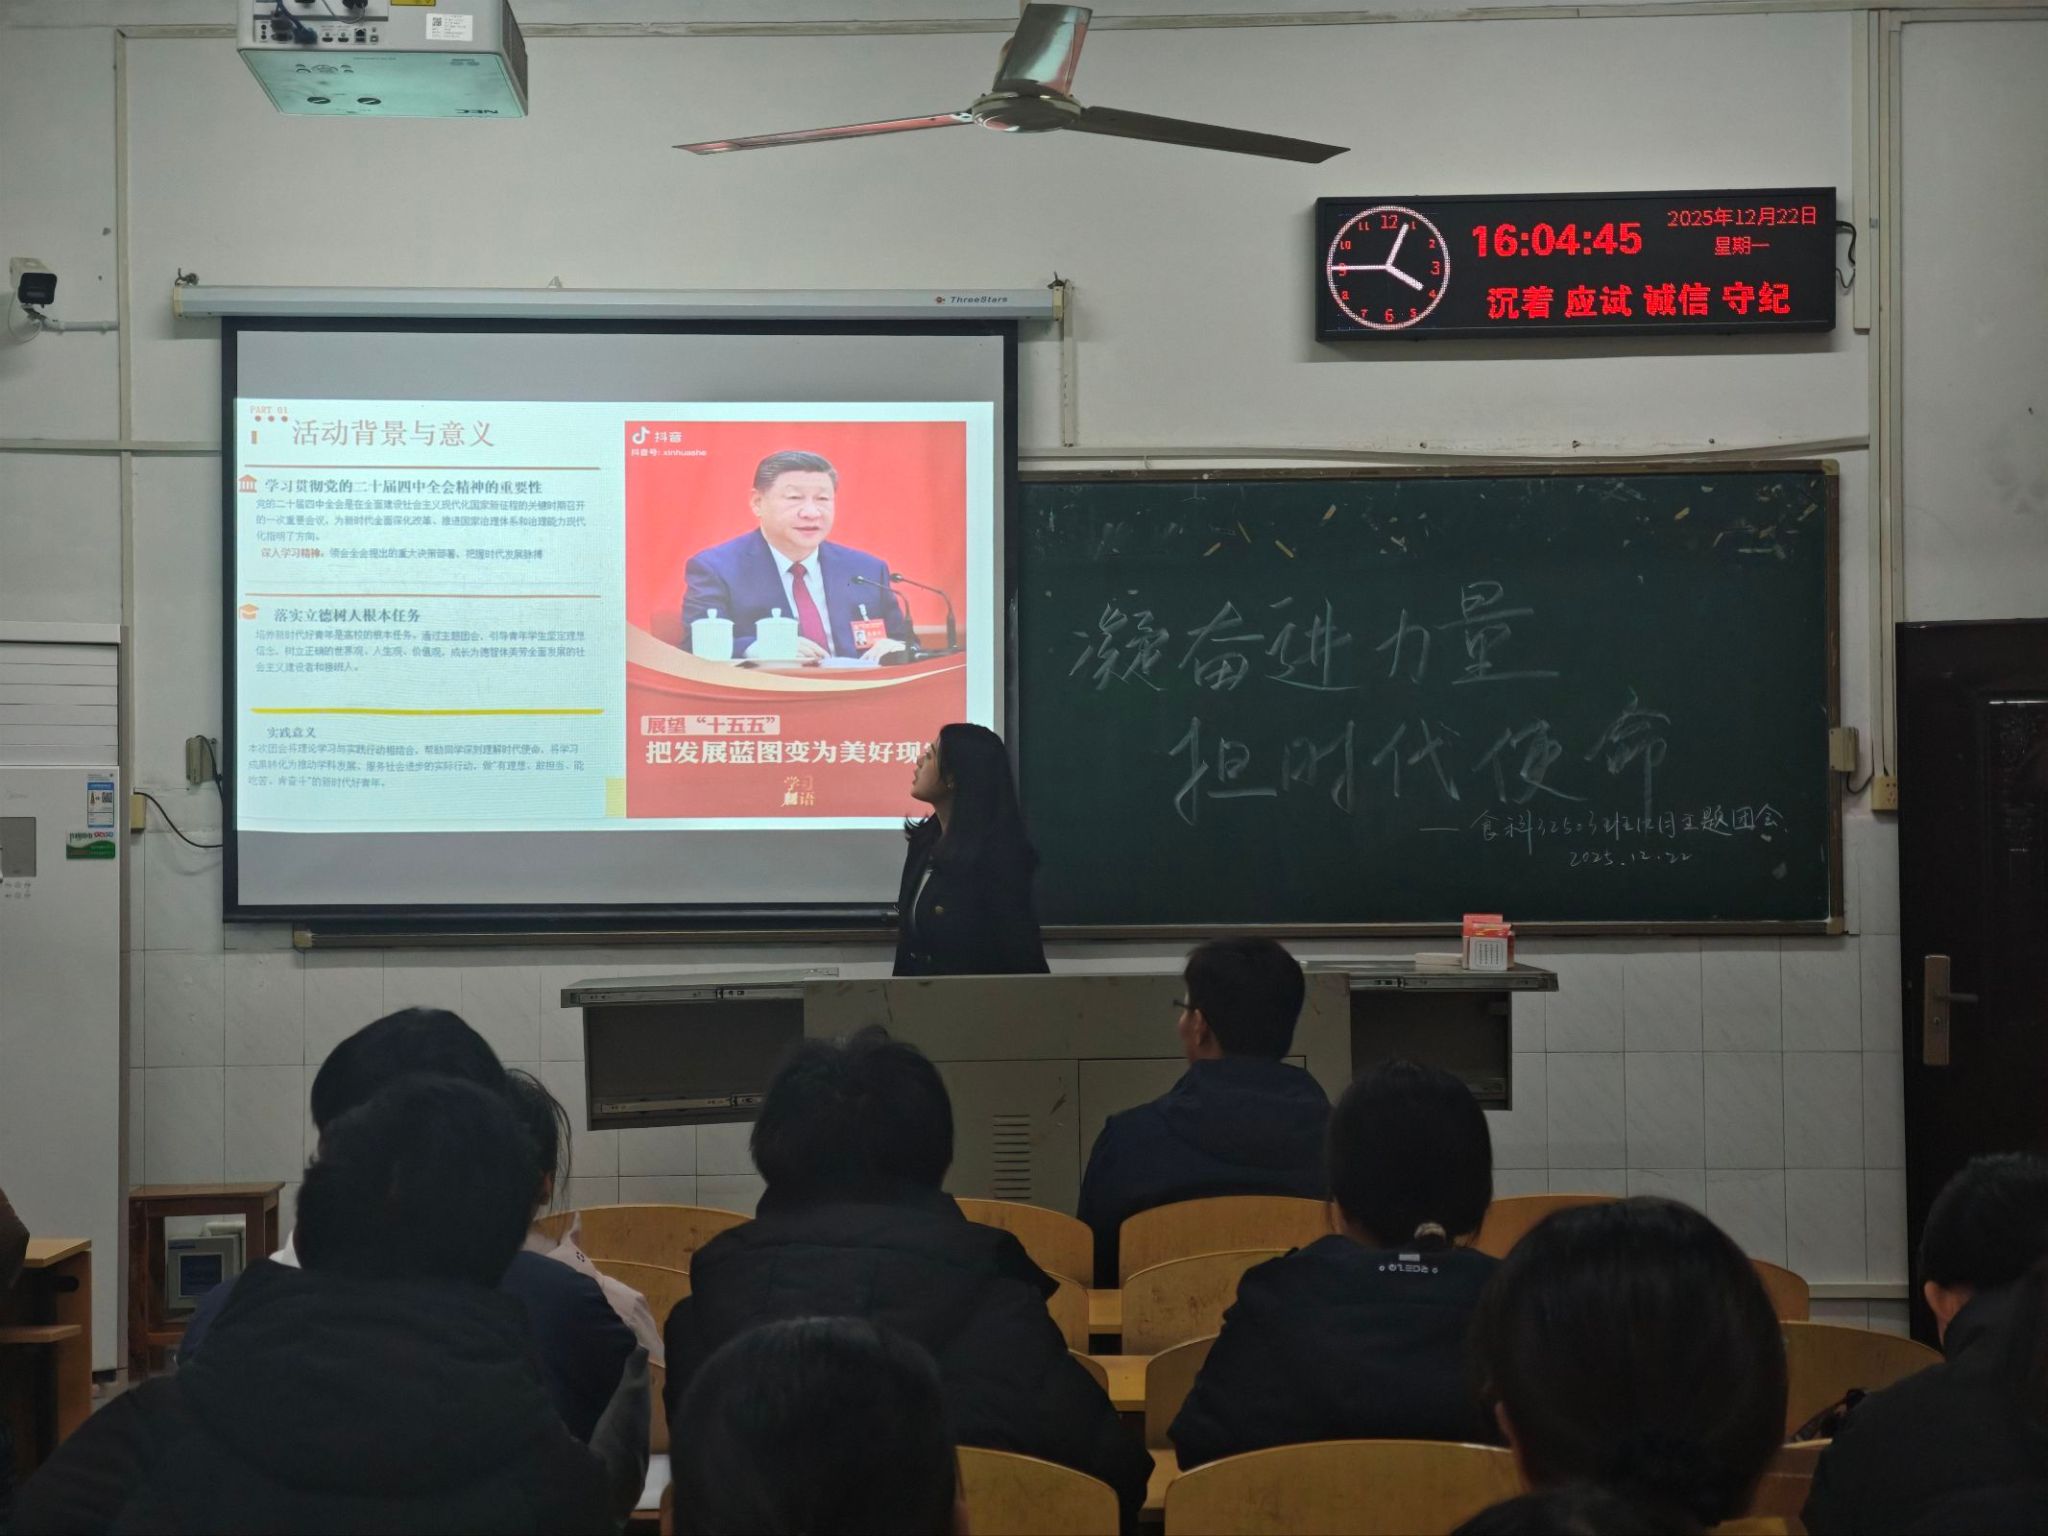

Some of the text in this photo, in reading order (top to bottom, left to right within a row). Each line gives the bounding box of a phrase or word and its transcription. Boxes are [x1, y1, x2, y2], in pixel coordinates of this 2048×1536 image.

[1381, 215, 1398, 229] 12
[1667, 206, 1817, 227] 2025年12月22日
[1359, 222, 1370, 231] 11
[1340, 240, 1351, 250] 10
[1429, 239, 1436, 249] 2
[1473, 222, 1642, 257] 16:04:45
[1714, 236, 1770, 256] 星期一
[1431, 261, 1441, 276] 3
[950, 296, 1008, 304] ThreeStars
[1341, 290, 1350, 301] 8
[1428, 289, 1438, 299] 4
[1488, 281, 1791, 319] 沉着 应试 诚信 守纪
[1360, 308, 1368, 318] 7
[1384, 308, 1395, 323] 6
[1409, 308, 1418, 318] 5
[292, 419, 495, 447] 活动背景与意义
[654, 431, 682, 444] 抖音
[265, 478, 543, 495] 学习贯彻党的二十届四中全会精神的重要性
[274, 608, 421, 623] 落实立德树人根本任务
[1069, 581, 1560, 691] 凝奋进力量
[267, 726, 317, 740] 实践意义
[646, 740, 931, 765] 把发展蓝图变为美好现
[1168, 687, 1672, 830] 担时代使命
